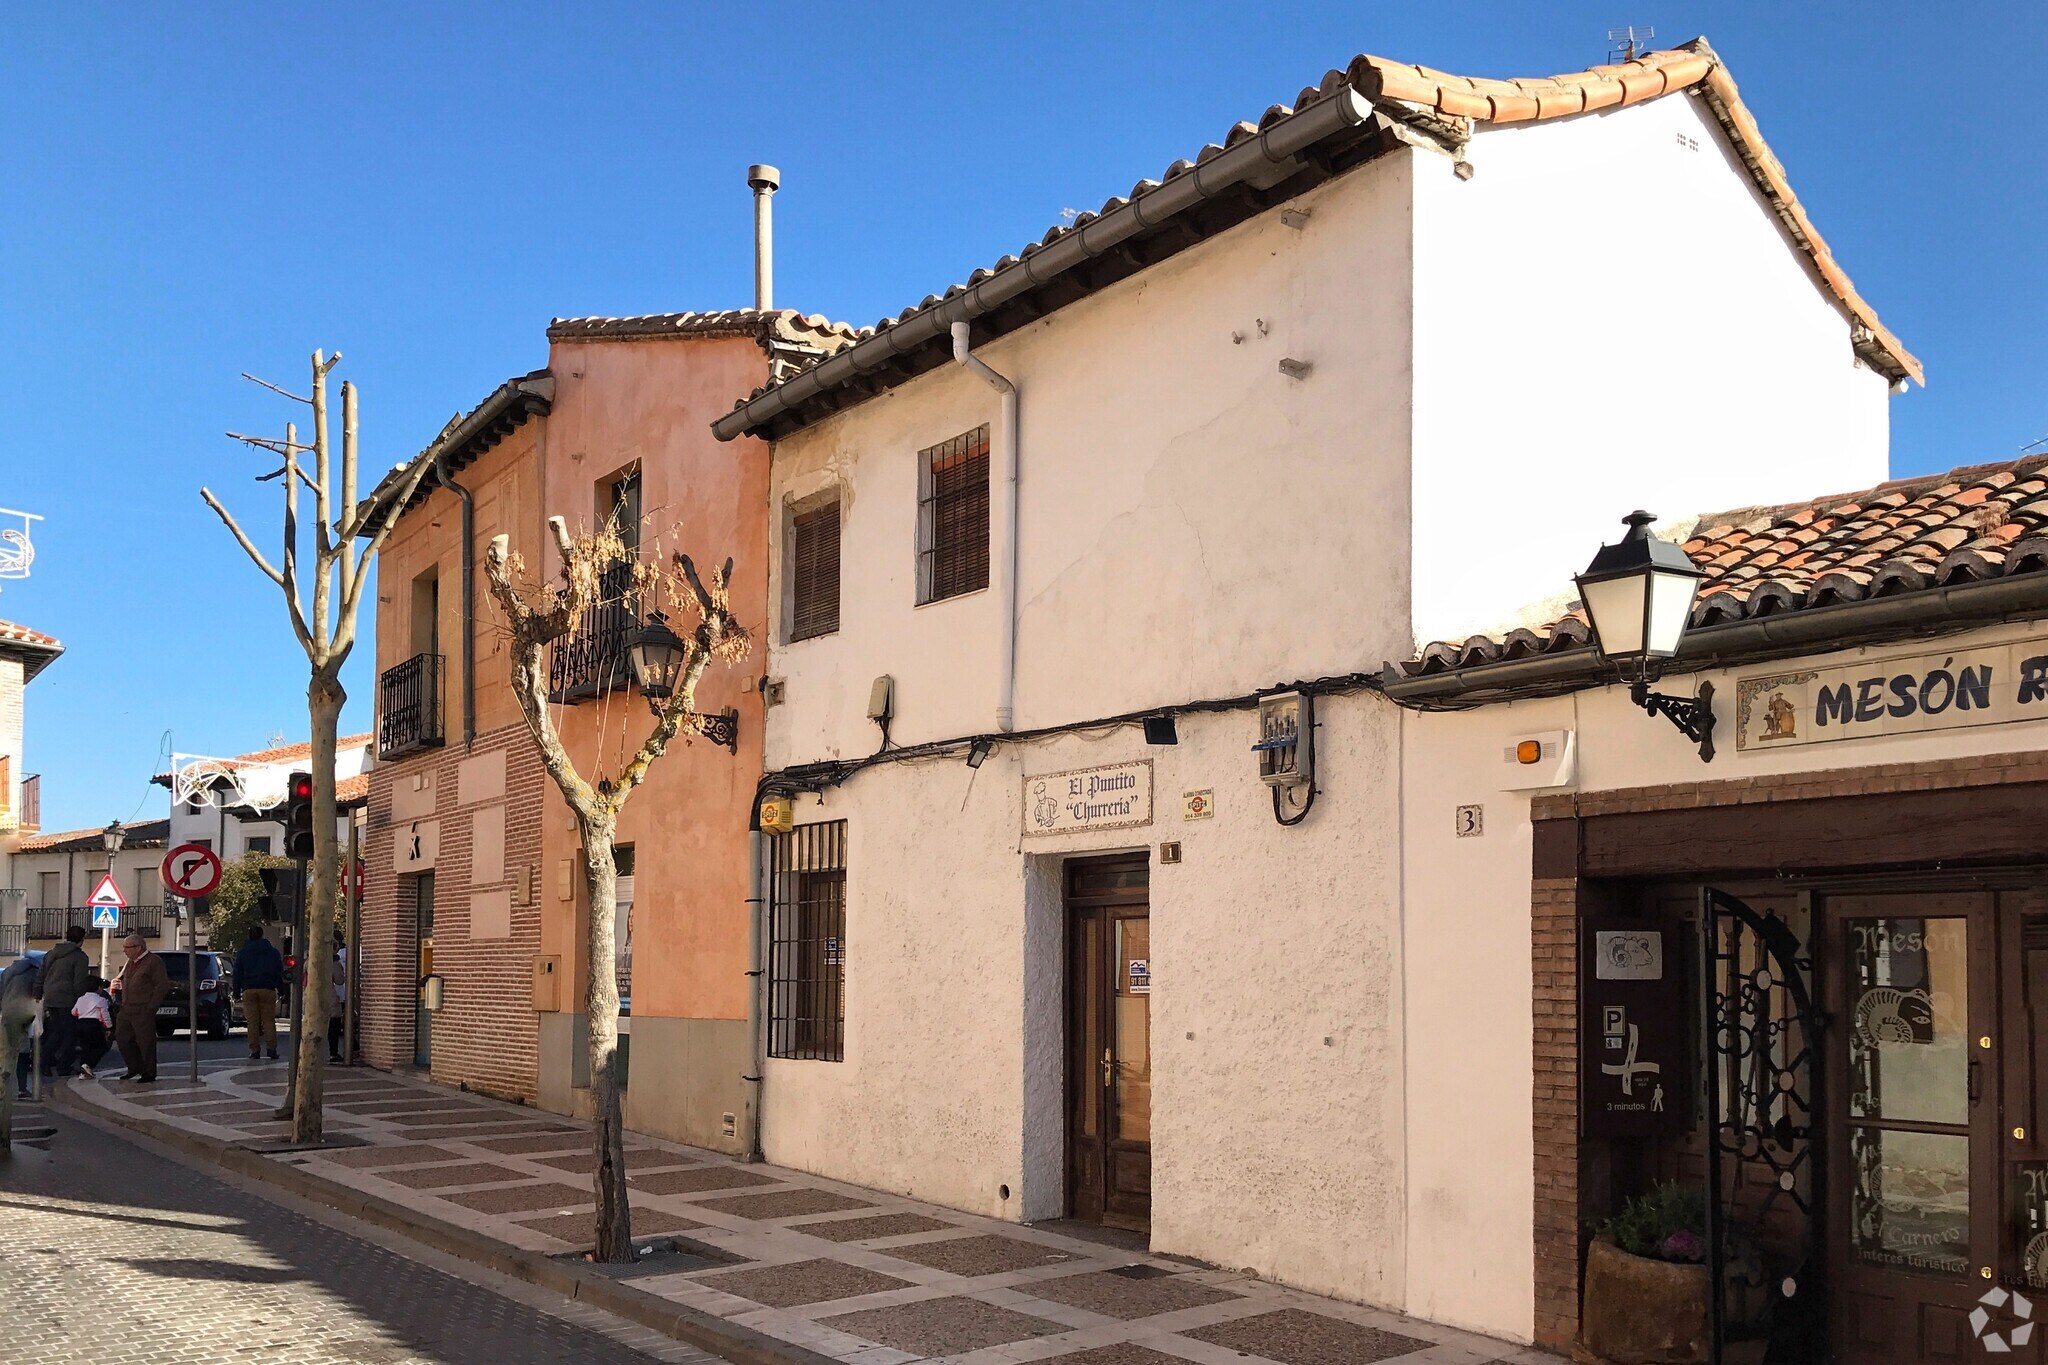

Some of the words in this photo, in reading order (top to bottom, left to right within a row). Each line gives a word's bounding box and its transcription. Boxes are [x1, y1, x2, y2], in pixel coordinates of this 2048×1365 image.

[1815, 657, 1993, 727] MESÓN
[1068, 777, 1083, 800] El
[1087, 772, 1136, 800] Puntito
[1463, 810, 1475, 833] 3
[1607, 1010, 1621, 1031] P
[1606, 1102, 1613, 1111] 3
[1614, 1102, 1646, 1111] minutos
[1888, 1226, 1961, 1246] Carnero
